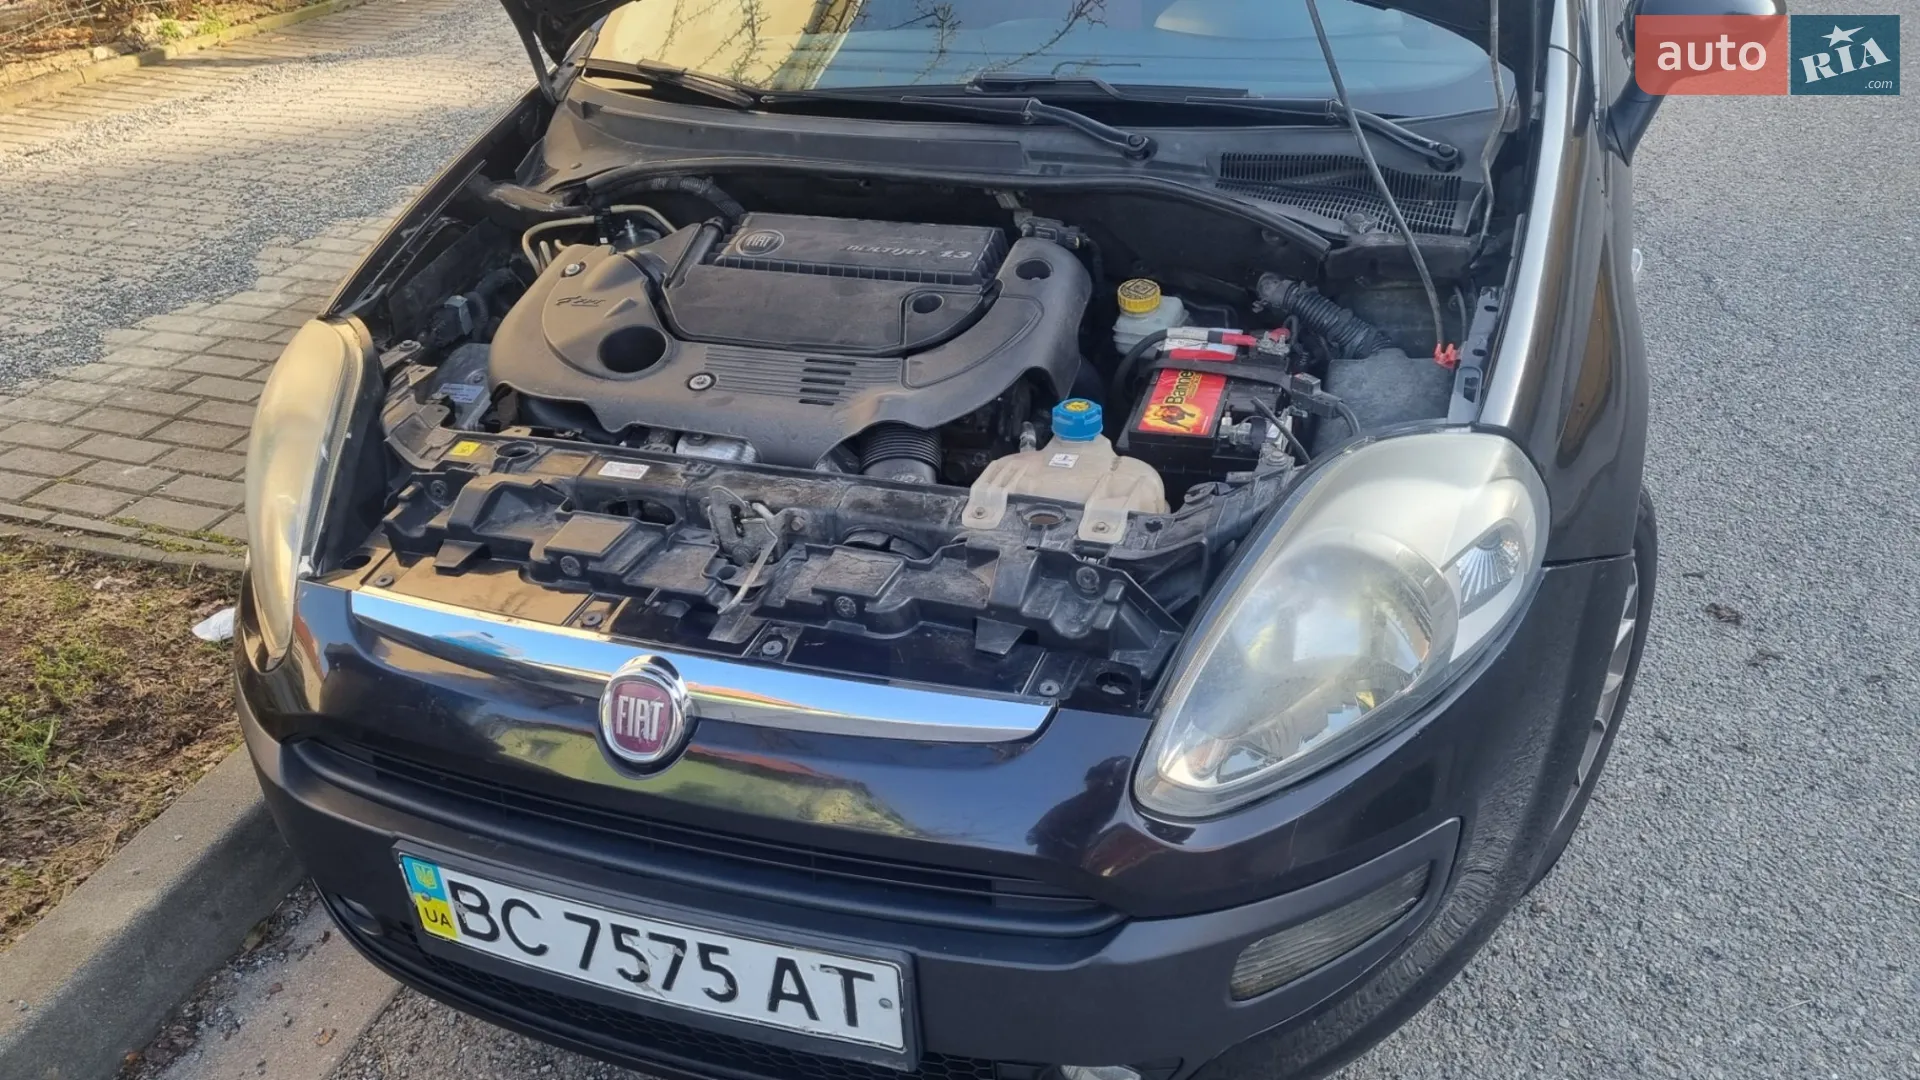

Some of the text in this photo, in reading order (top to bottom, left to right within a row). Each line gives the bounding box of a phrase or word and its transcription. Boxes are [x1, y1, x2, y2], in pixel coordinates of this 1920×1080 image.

[1163, 369, 1195, 405] Banne
[616, 695, 665, 741] FIAT
[424, 907, 453, 929] UA
[448, 879, 876, 1027] BC 7575 AT
